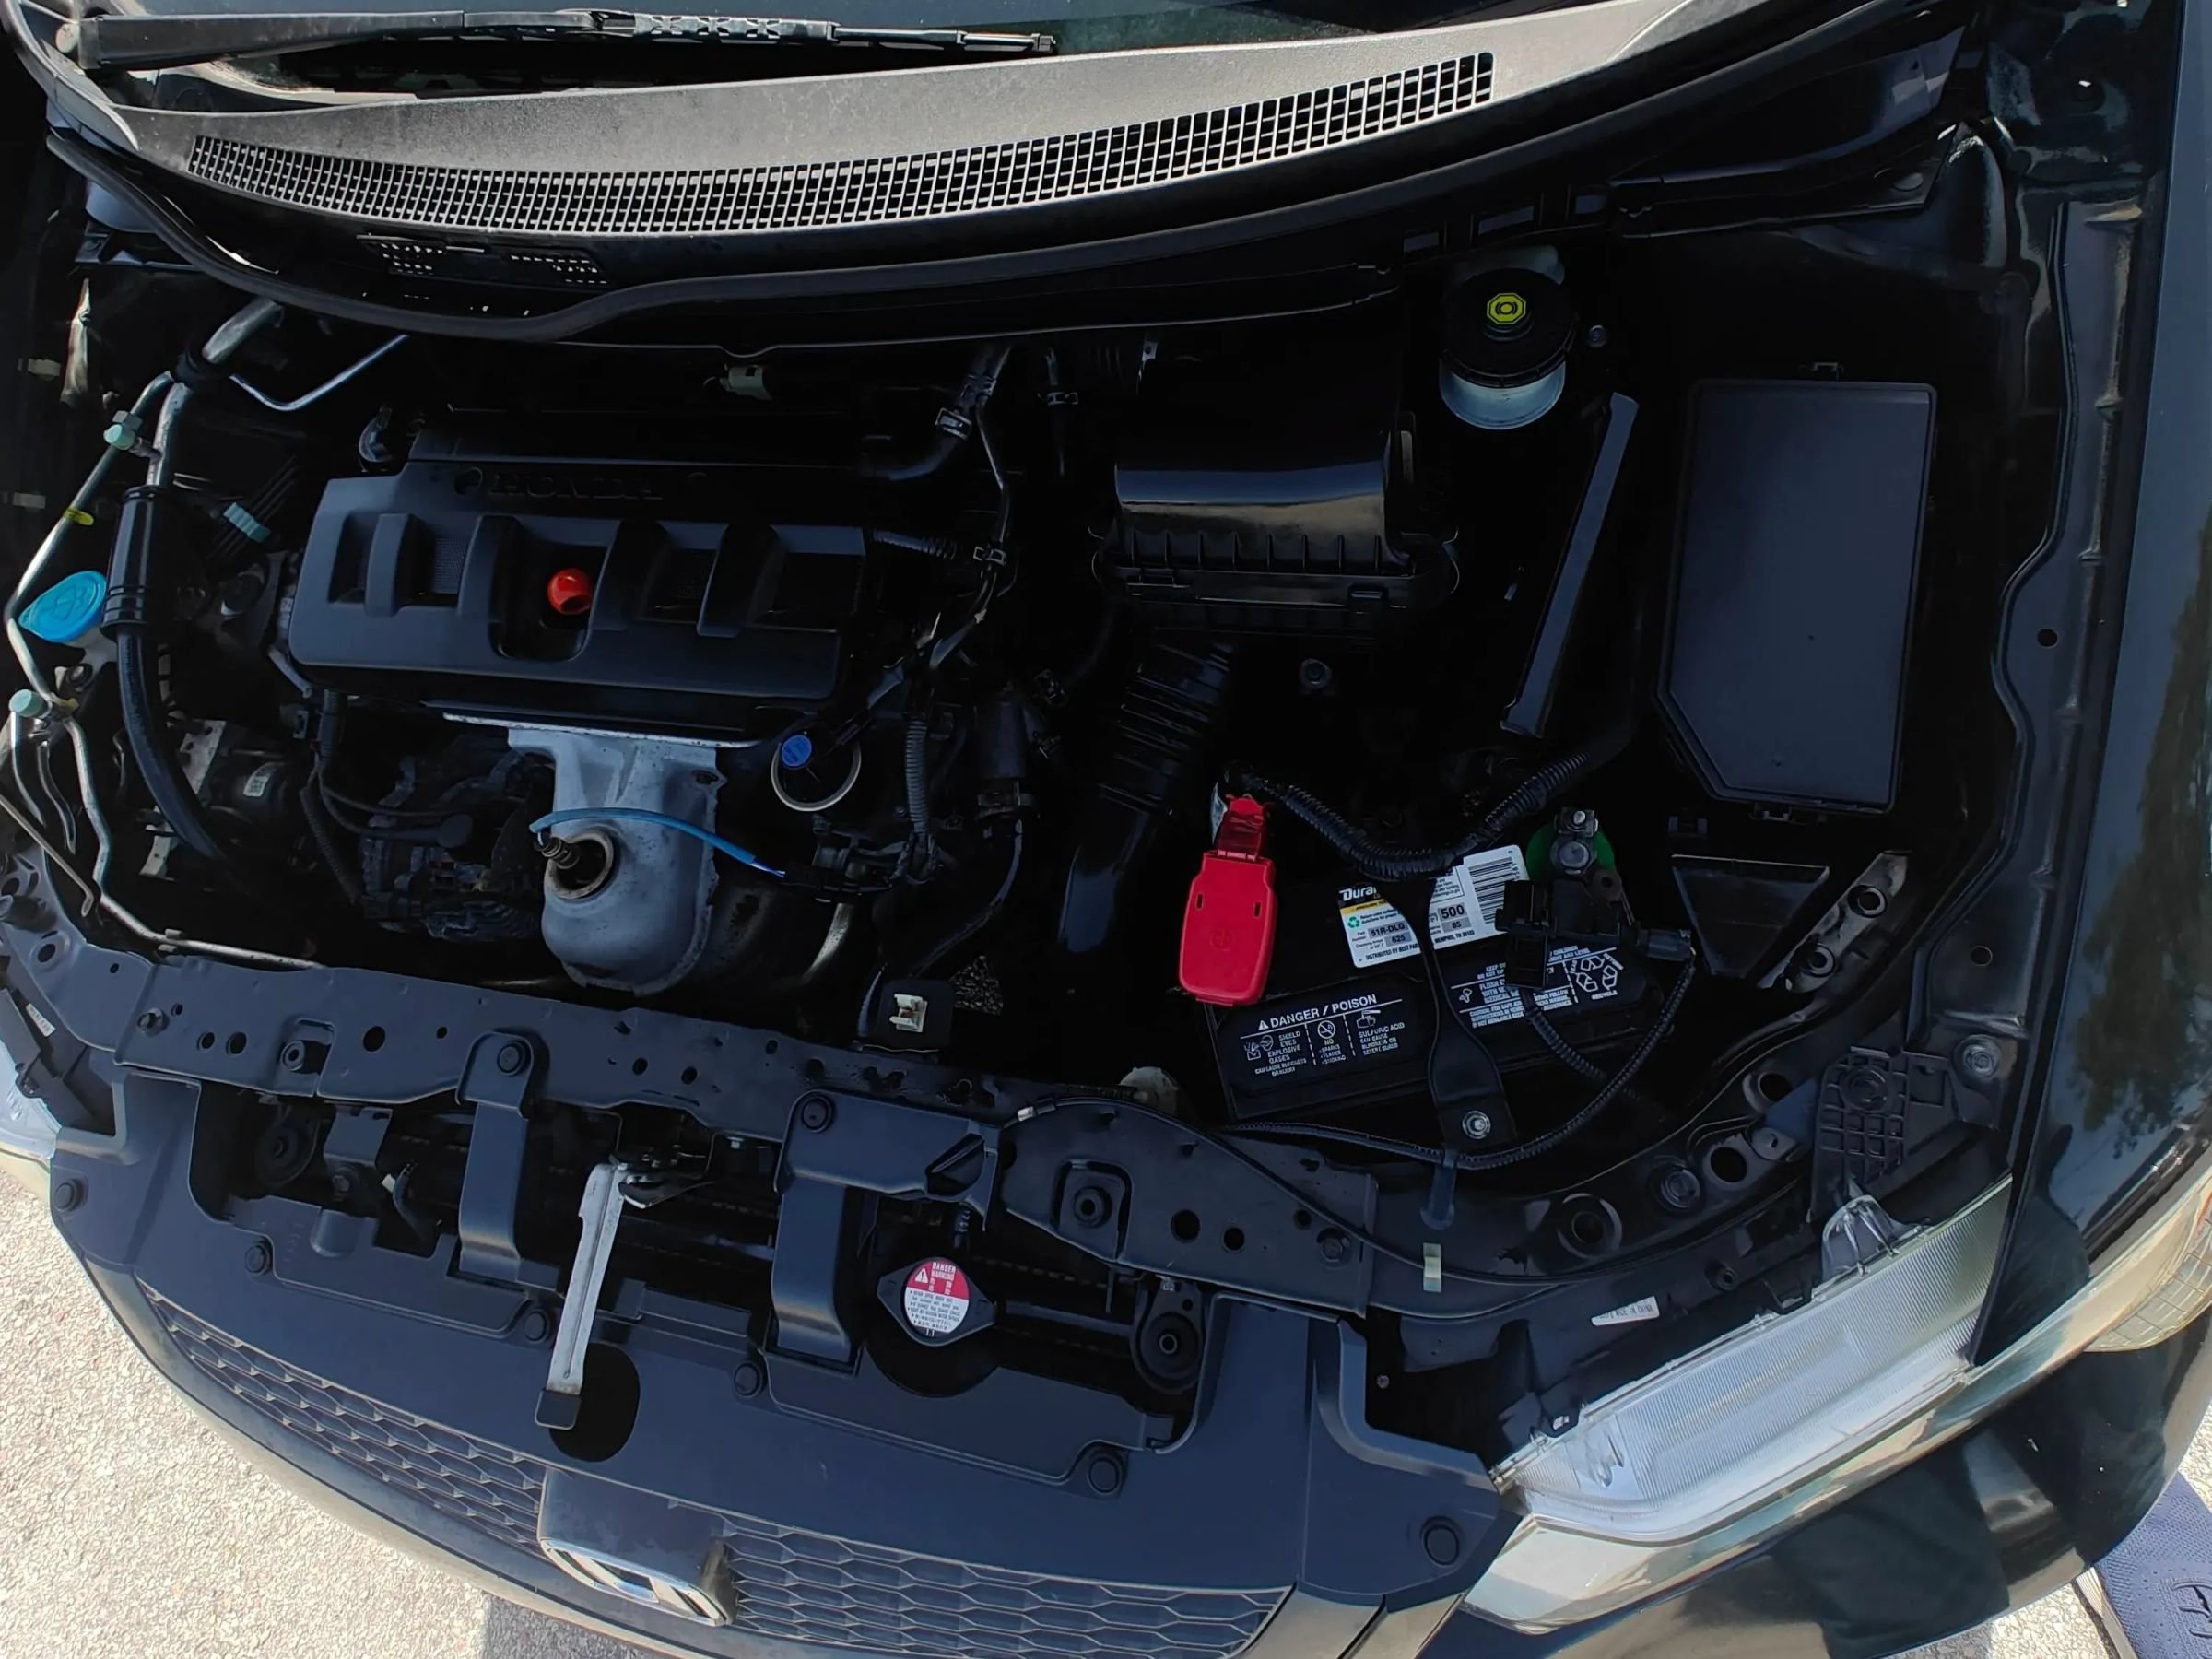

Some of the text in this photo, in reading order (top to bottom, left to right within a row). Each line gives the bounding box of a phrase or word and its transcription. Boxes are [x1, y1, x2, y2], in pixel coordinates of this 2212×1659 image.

[1441, 904, 1464, 918] 500
[1371, 923, 1405, 935] 51R-DLG
[1392, 935, 1405, 943] 625
[1366, 949, 1391, 959] DISTRIBUTED
[1591, 989, 1618, 1000] RECYCLE
[1270, 1007, 1319, 1027] DANGER
[1332, 993, 1376, 1013] POISON
[1358, 1021, 1405, 1038] SULFURIC ACID
[1278, 1030, 1300, 1041] SHIELD
[1371, 1032, 1387, 1041] CAUSE
[1280, 1039, 1296, 1047] EYES
[1267, 1044, 1300, 1057] EXPLOSIVE
[1268, 1053, 1289, 1064] GASES
[932, 1261, 956, 1273] DANGER
